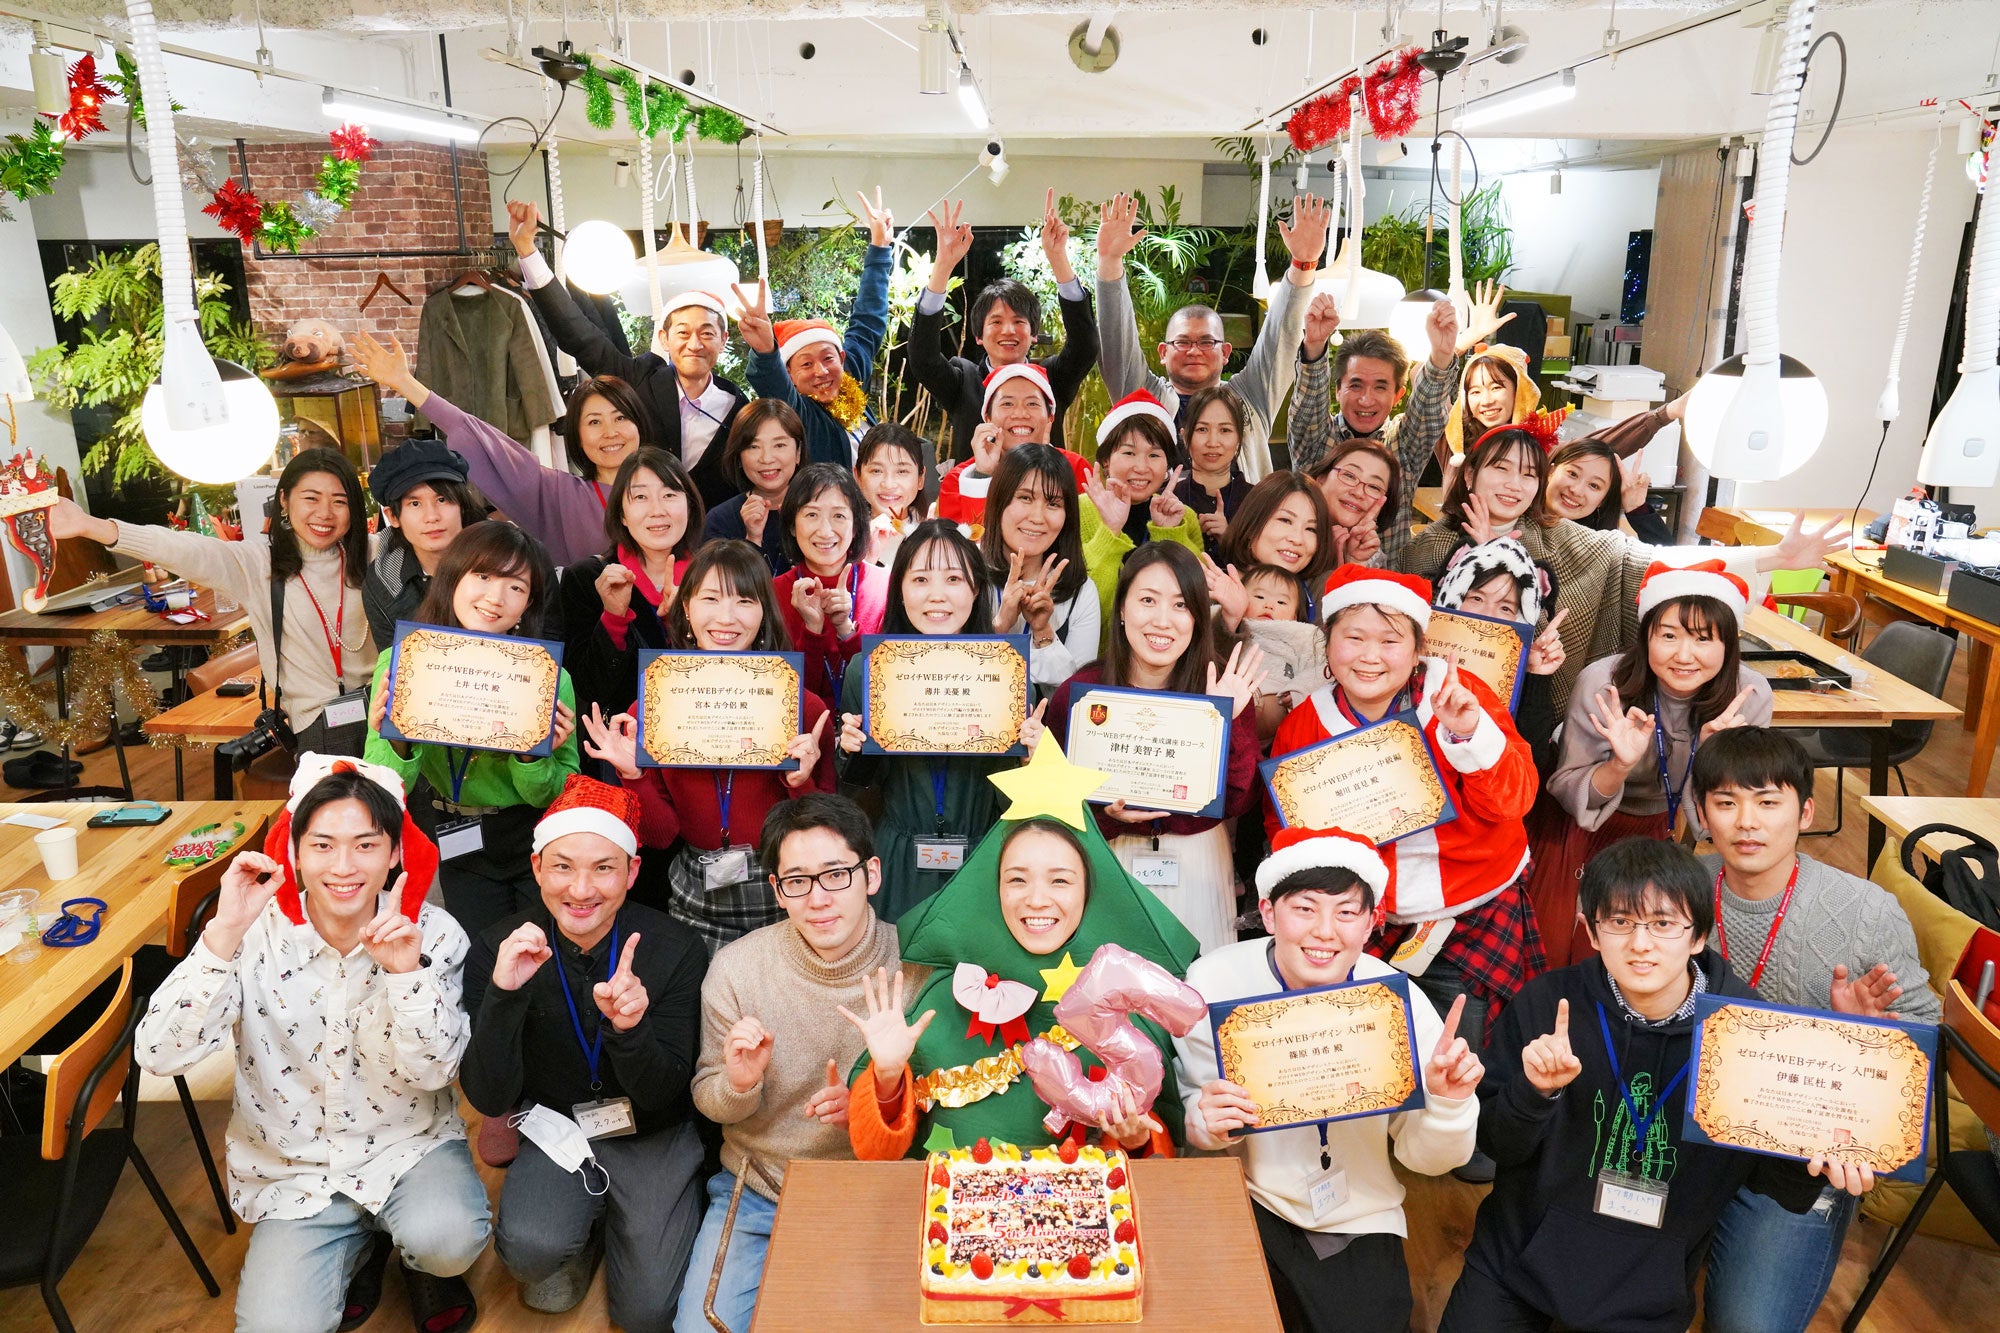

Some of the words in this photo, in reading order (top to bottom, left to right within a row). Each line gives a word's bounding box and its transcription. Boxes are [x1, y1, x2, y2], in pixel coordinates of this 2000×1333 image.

[1472, 648, 1496, 660] 中級編
[425, 662, 504, 679] ゼロイチWEBデザイン
[507, 673, 531, 683] 入門編
[895, 673, 972, 682] ゼロイチWEBデザイン
[975, 673, 1001, 683] 入門編
[454, 680, 470, 689] 土井
[474, 682, 489, 691] 七代
[492, 683, 501, 693] 殿
[669, 687, 745, 696] ゼロイチWEBデザイン
[748, 687, 774, 696] 中級編
[924, 687, 941, 696] 薄井
[962, 687, 971, 696] 殿
[694, 701, 711, 710] 宮本
[740, 701, 748, 710] 殿
[1092, 710, 1106, 719] JDS
[1086, 729, 1179, 746] フリーWEBデザイナー養成講座
[1180, 738, 1206, 749] Bコース
[1110, 742, 1130, 754] 津村
[1134, 745, 1162, 757] 美智子
[1165, 747, 1176, 759] 殿
[1302, 763, 1374, 795] ゼロイチWEBデザイン
[1377, 753, 1402, 768] 中級編
[1135, 869, 1164, 878] つむつむ
[1252, 1029, 1343, 1050] ゼロイチWEBデザイン
[1347, 1021, 1377, 1036] 入門編
[1289, 1049, 1308, 1060] 篠原
[1312, 1045, 1330, 1056] 勇希
[1334, 1043, 1344, 1053] 殿
[1737, 1048, 1847, 1073] ゼロイチWEBデザイン
[1852, 1066, 1888, 1081] 入門編
[1776, 1071, 1799, 1084] 伊藤
[1803, 1077, 1827, 1089] 匡杜
[1830, 1079, 1843, 1092] 殿
[954, 1191, 996, 1205] Japan
[1000, 1190, 1049, 1204] Design
[1052, 1187, 1098, 1199] School
[994, 1225, 1023, 1239] 5th
[1023, 1224, 1108, 1239] Anniversary
